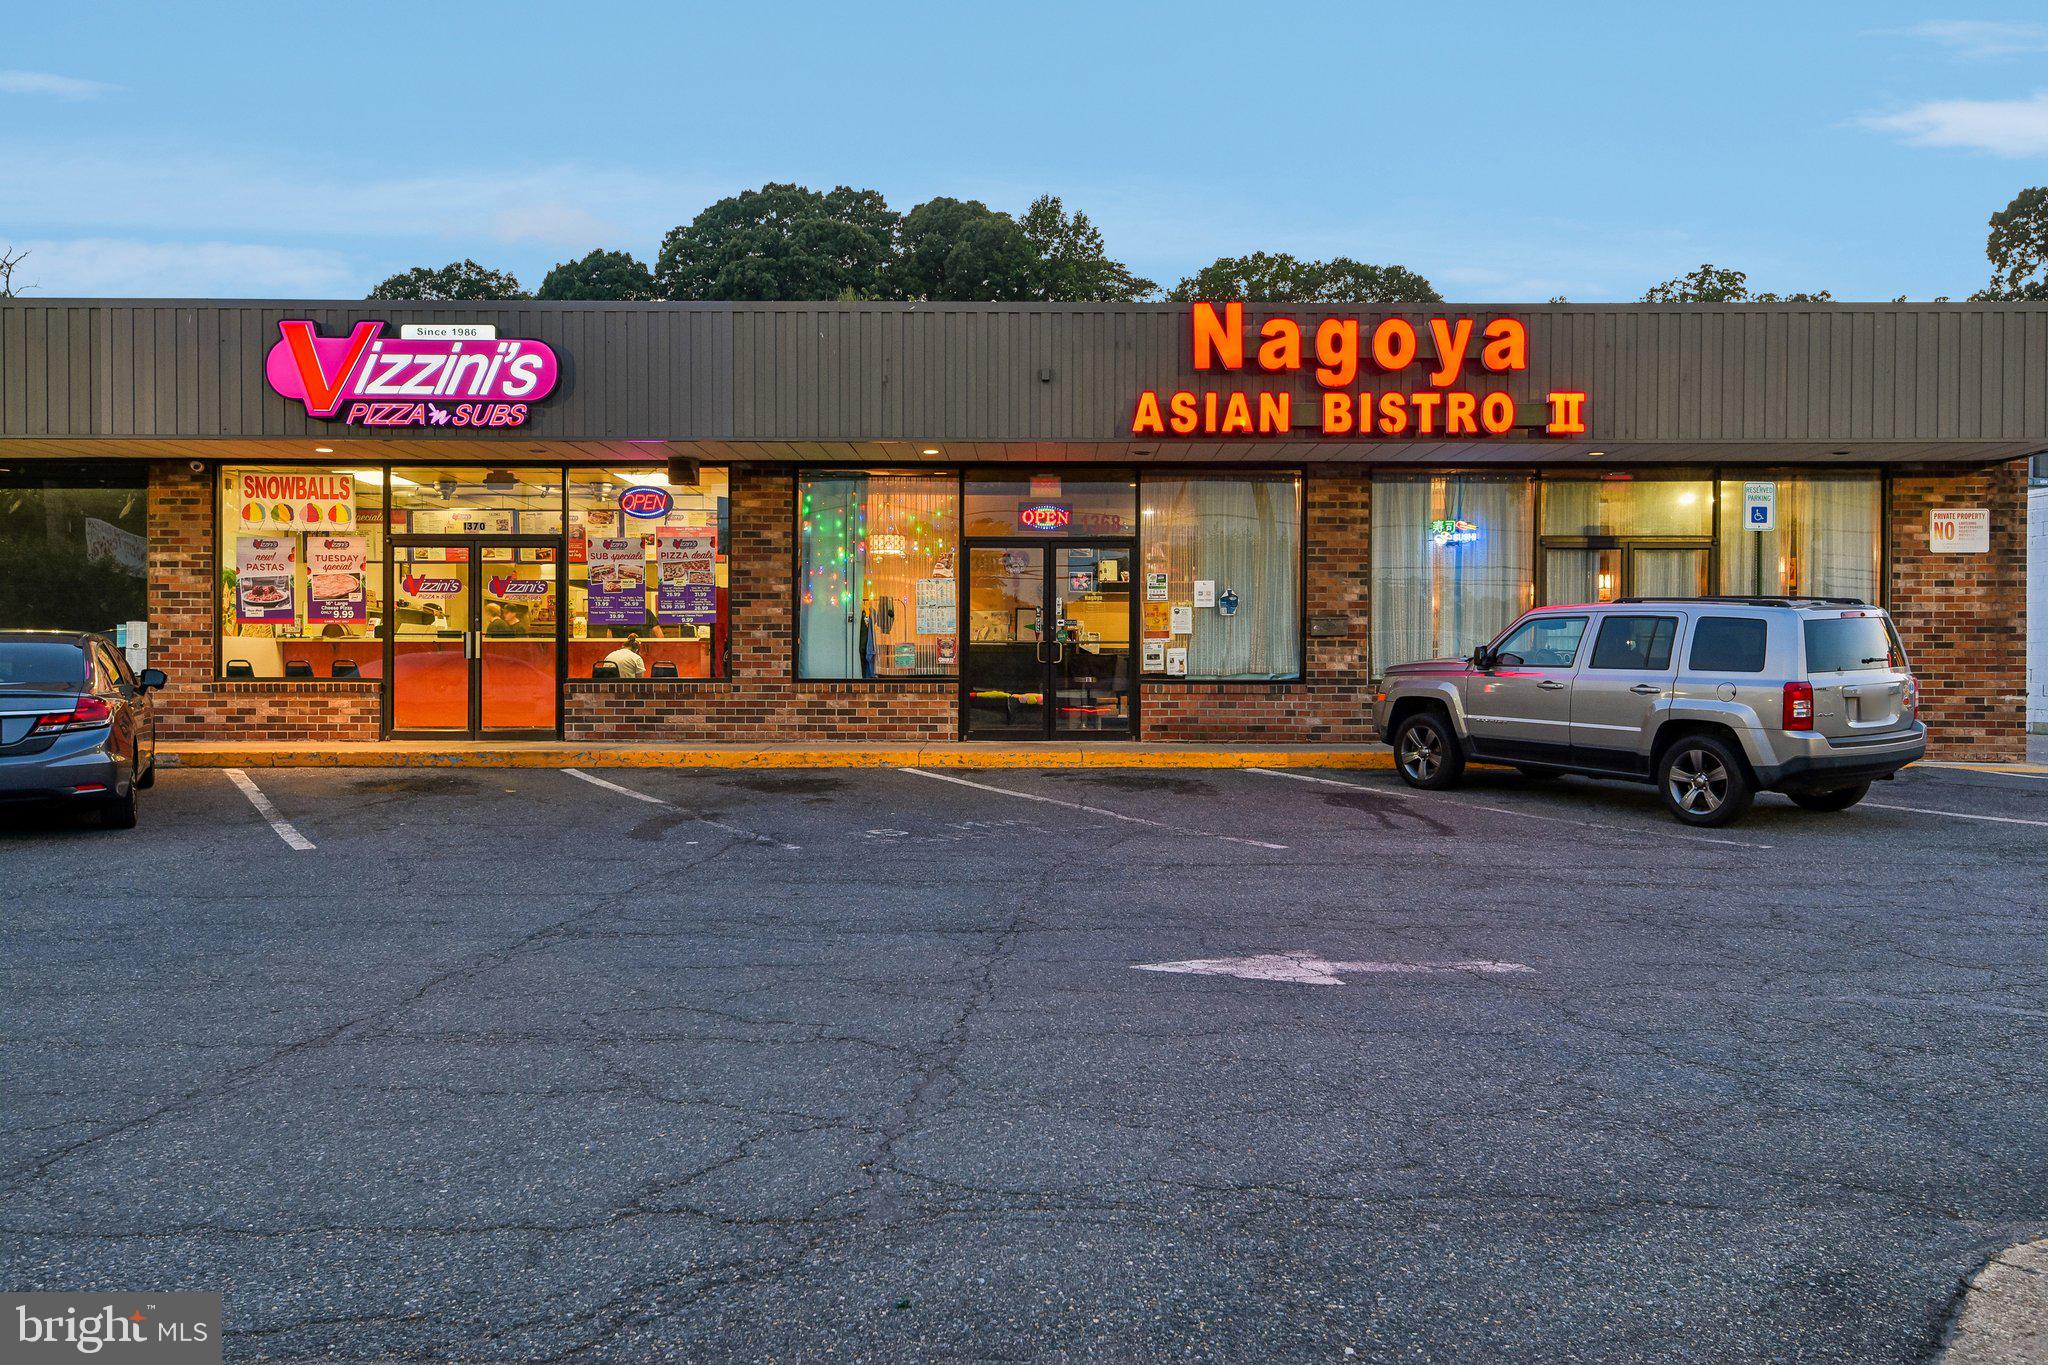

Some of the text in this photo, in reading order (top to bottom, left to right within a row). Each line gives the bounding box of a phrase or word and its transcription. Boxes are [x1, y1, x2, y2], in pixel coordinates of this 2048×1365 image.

[416, 327, 477, 337] Since 1986
[1193, 301, 1527, 388] Nagoya
[281, 322, 543, 412] Vizzini's
[346, 402, 425, 425] PIZZA
[452, 403, 528, 426] SUBS
[1131, 391, 1586, 434] ASIAN BISTRO II
[243, 475, 350, 500] SNOWBALLS
[621, 493, 667, 511] OPEN
[1021, 510, 1070, 526] OPEN
[1933, 512, 1986, 520] PRIVATE PROPERTY
[463, 522, 486, 531] 1370
[1933, 521, 1955, 541] NO
[254, 552, 277, 561] new!
[315, 554, 359, 562] TUESDAY
[590, 552, 609, 560] SUB
[610, 553, 643, 561] specials
[660, 550, 714, 559] PIZZA deals
[246, 563, 285, 571] PASTAS
[322, 561, 353, 571] special
[405, 574, 460, 596] Vizzini's
[491, 575, 546, 597] Vizzini's
[333, 610, 354, 619] 9.99
